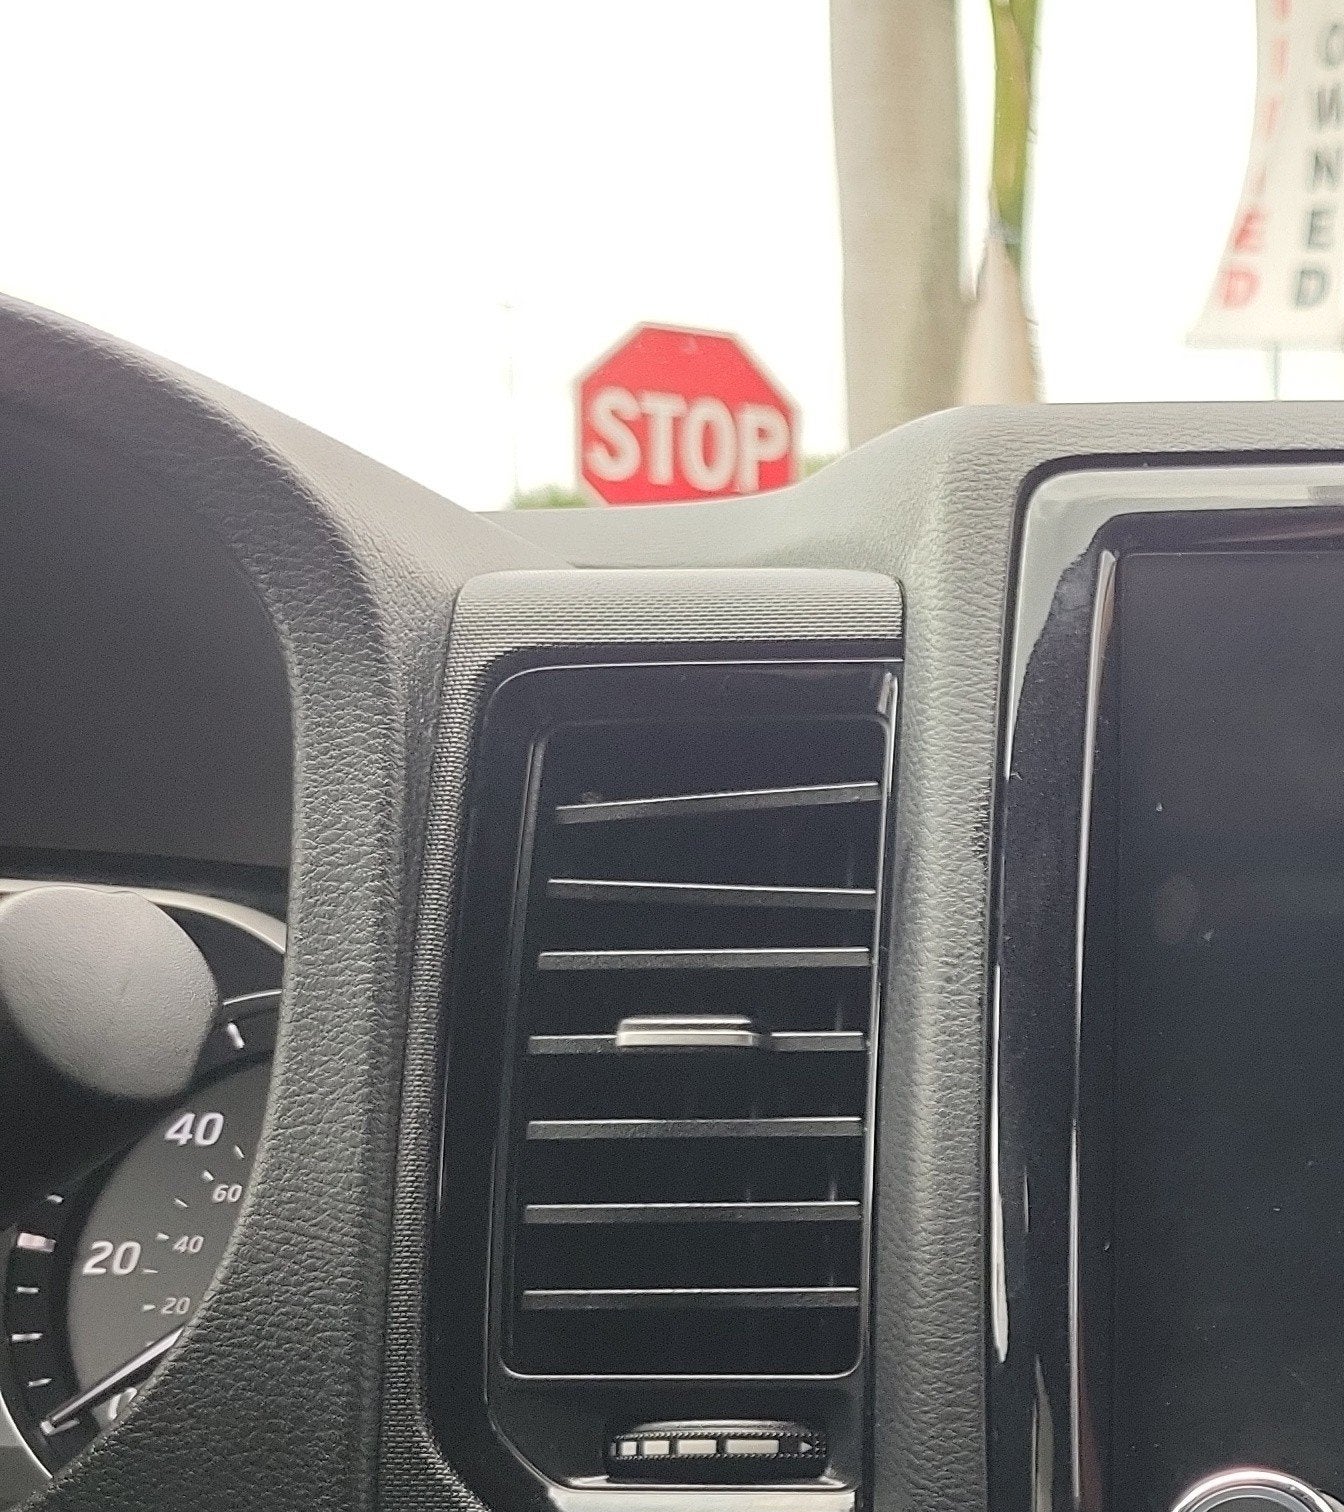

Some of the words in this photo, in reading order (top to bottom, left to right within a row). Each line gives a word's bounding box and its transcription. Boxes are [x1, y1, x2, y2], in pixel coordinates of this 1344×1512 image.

[586, 386, 792, 494] STOP
[164, 1112, 225, 1146] 40
[212, 1184, 243, 1203] 60
[172, 1235, 204, 1254] 40
[82, 1241, 141, 1275] 20
[160, 1297, 190, 1315] 20
